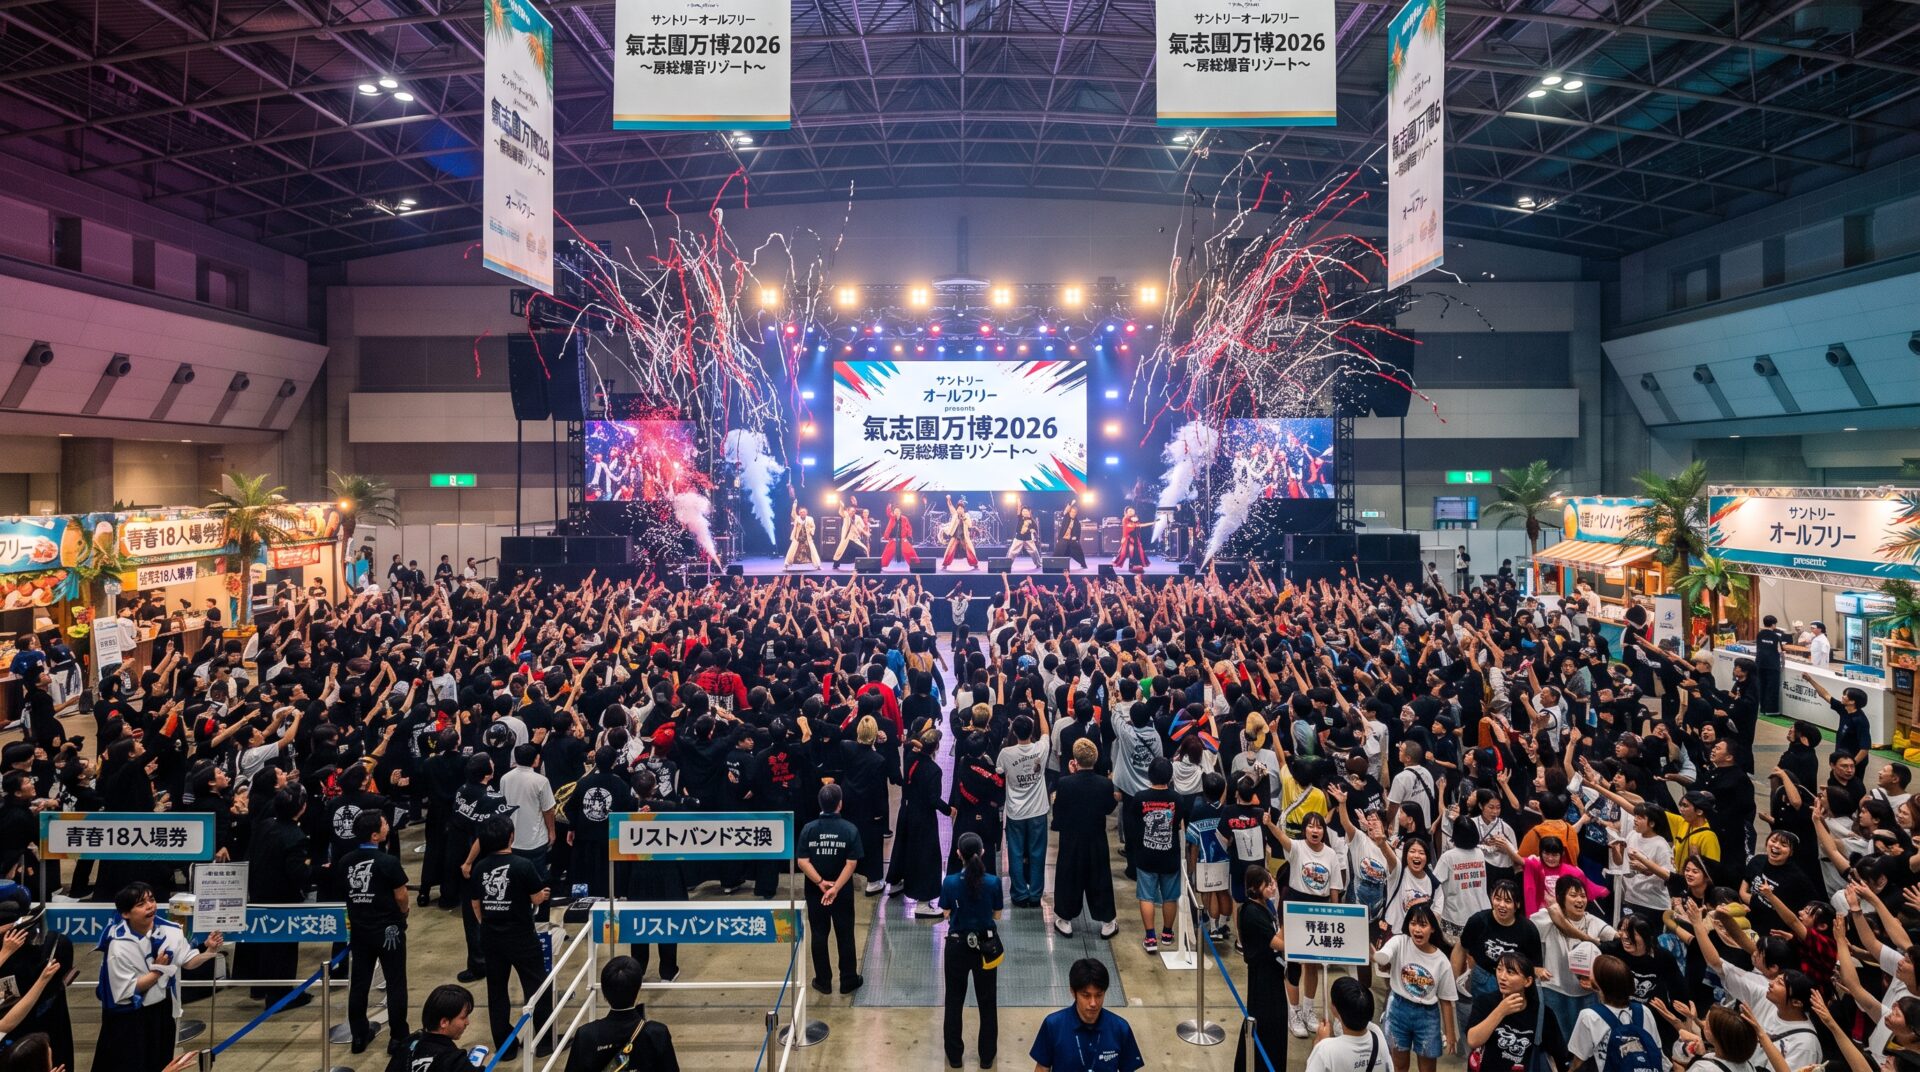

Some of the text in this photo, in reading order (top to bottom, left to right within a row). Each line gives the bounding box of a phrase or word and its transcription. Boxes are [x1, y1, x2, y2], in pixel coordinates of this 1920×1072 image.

[651, 14, 756, 26] サントリーオールフリー
[1194, 13, 1300, 25] サントリーオールフリー
[625, 33, 781, 56] 氣志團万博2026
[1168, 32, 1326, 55] 氣志團万博2026
[936, 375, 984, 386] サントリー
[923, 388, 998, 403] オールフリー
[863, 414, 1058, 442] 氣志團万博2026
[1788, 506, 1836, 521] サントリー
[1770, 521, 1857, 548] オールフリー
[66, 826, 188, 848] 青春18入場券
[629, 826, 773, 848] リストバンド交換
[632, 916, 767, 937] リストバンド交換
